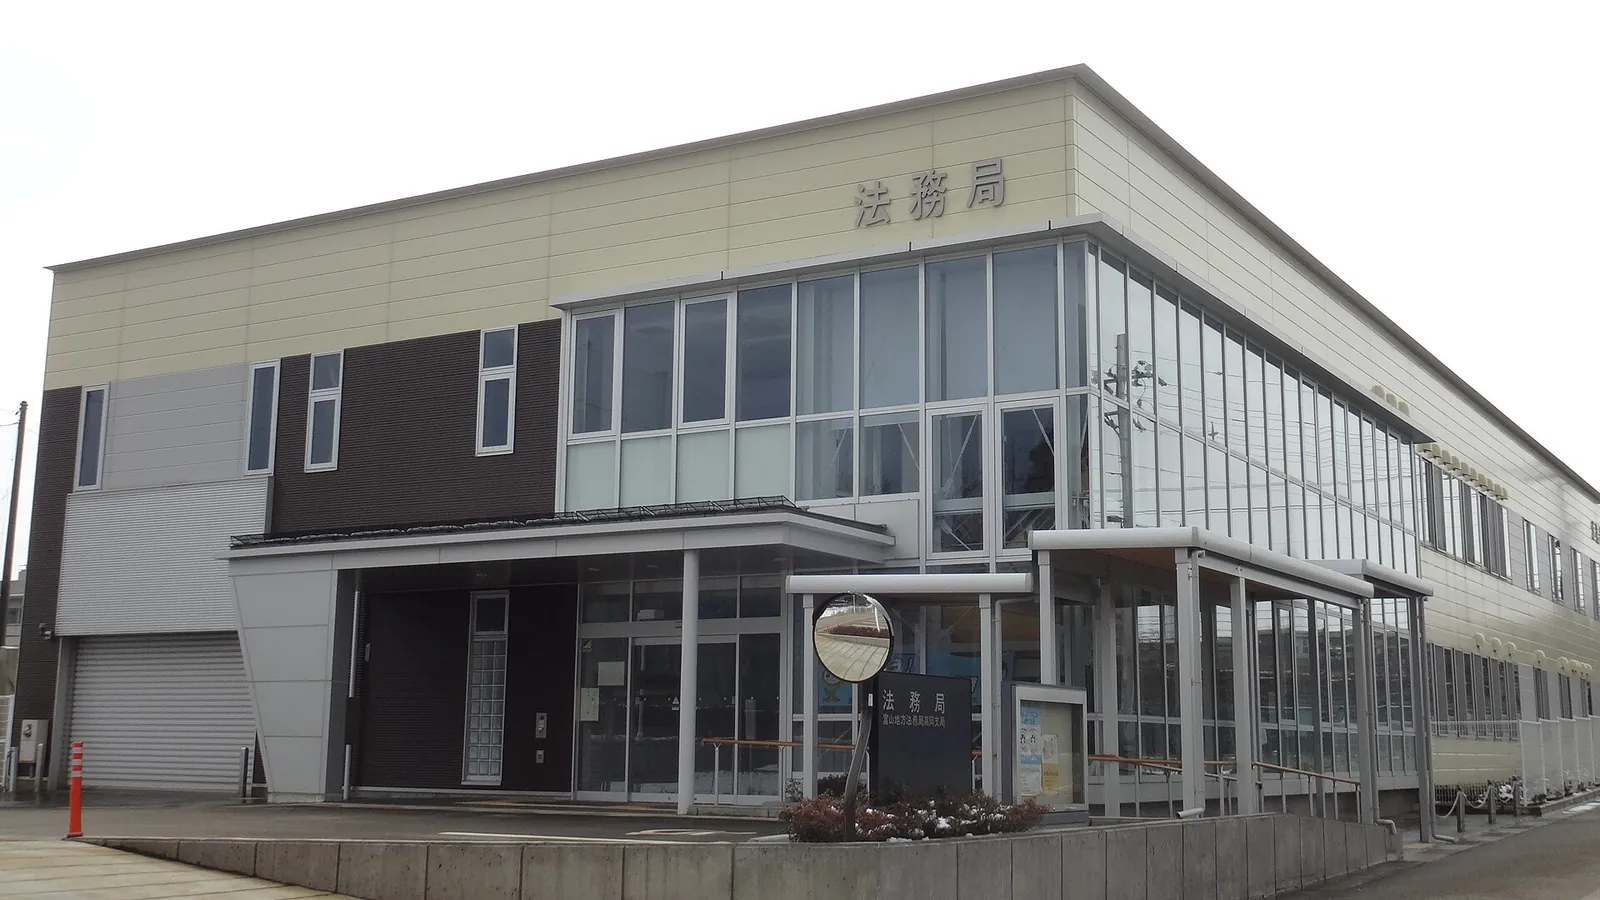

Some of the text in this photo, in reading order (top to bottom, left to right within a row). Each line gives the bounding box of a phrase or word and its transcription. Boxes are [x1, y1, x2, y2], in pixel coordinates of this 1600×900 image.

[855, 158, 1005, 227] 法務局
[883, 689, 945, 714] 法務局
